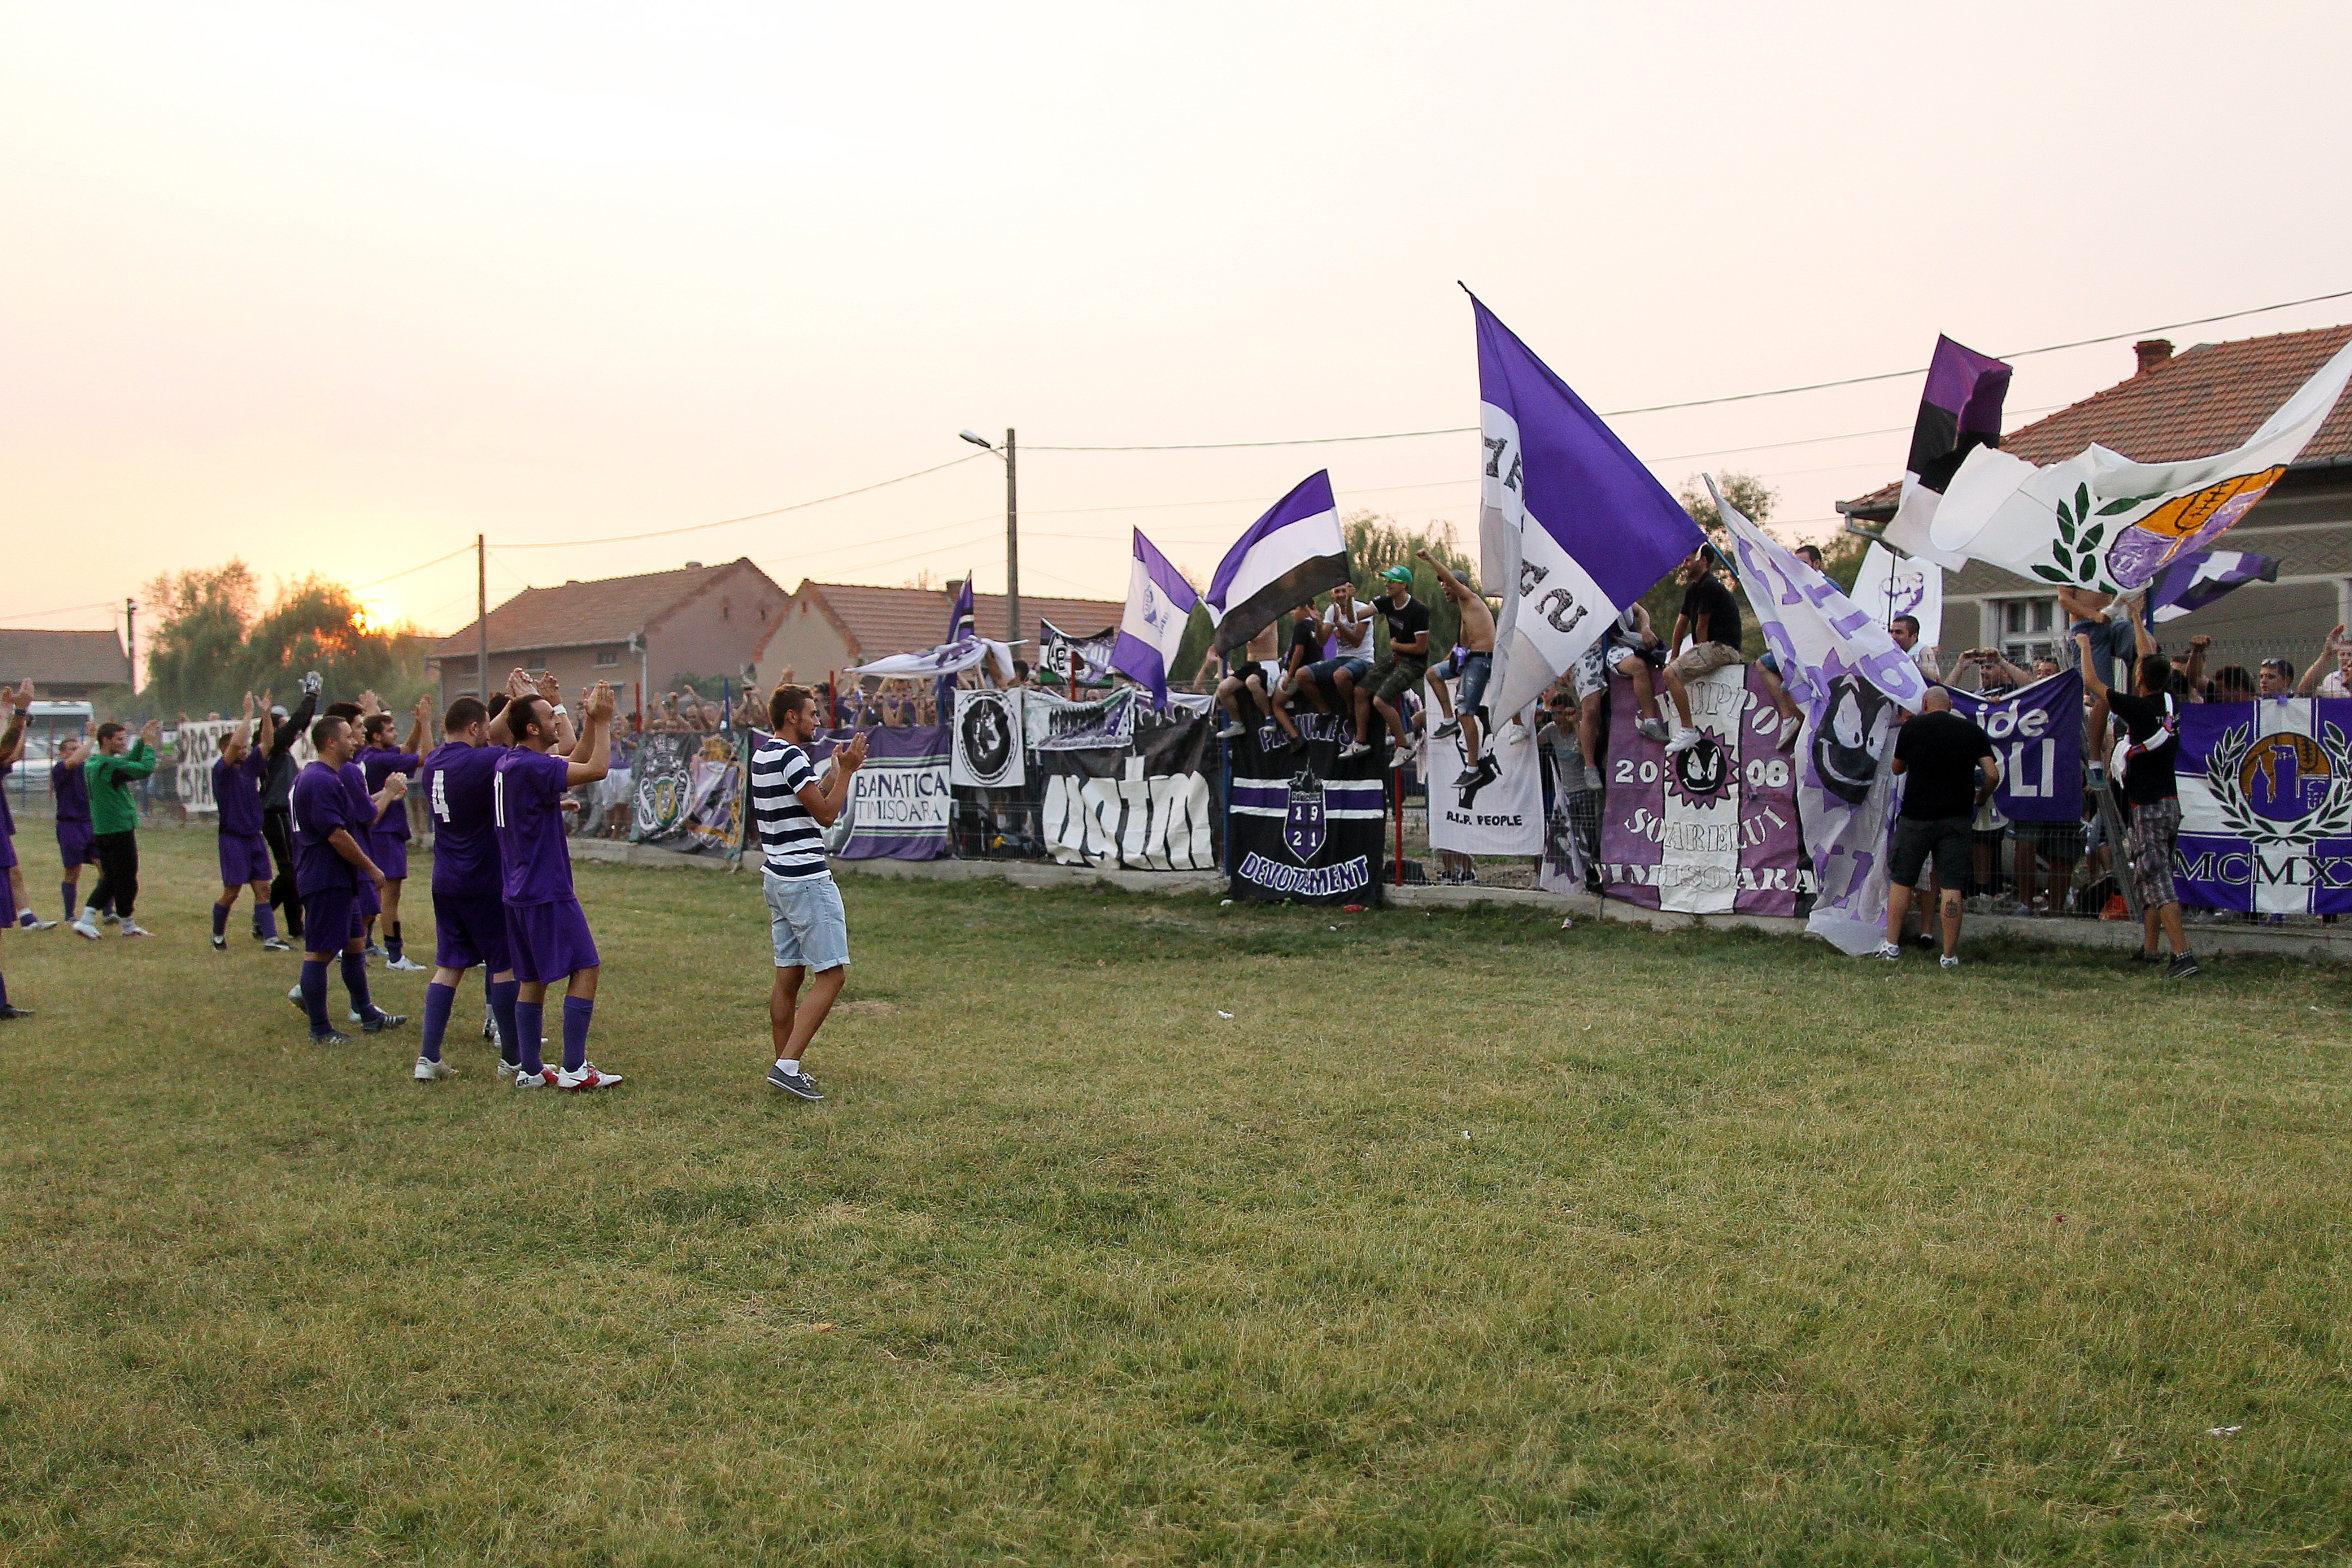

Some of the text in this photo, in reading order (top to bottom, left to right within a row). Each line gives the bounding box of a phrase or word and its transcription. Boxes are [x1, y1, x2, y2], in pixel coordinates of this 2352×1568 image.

[856, 770, 949, 798] BANATICA
[1615, 758, 1790, 788] 20 08
[432, 770, 451, 823] 4
[494, 770, 505, 828] 11
[1447, 811, 1522, 826] R.I.P. PEOPLE
[1624, 805, 1788, 851] SOARELUI
[1238, 851, 1369, 896] DEVOTAMENT
